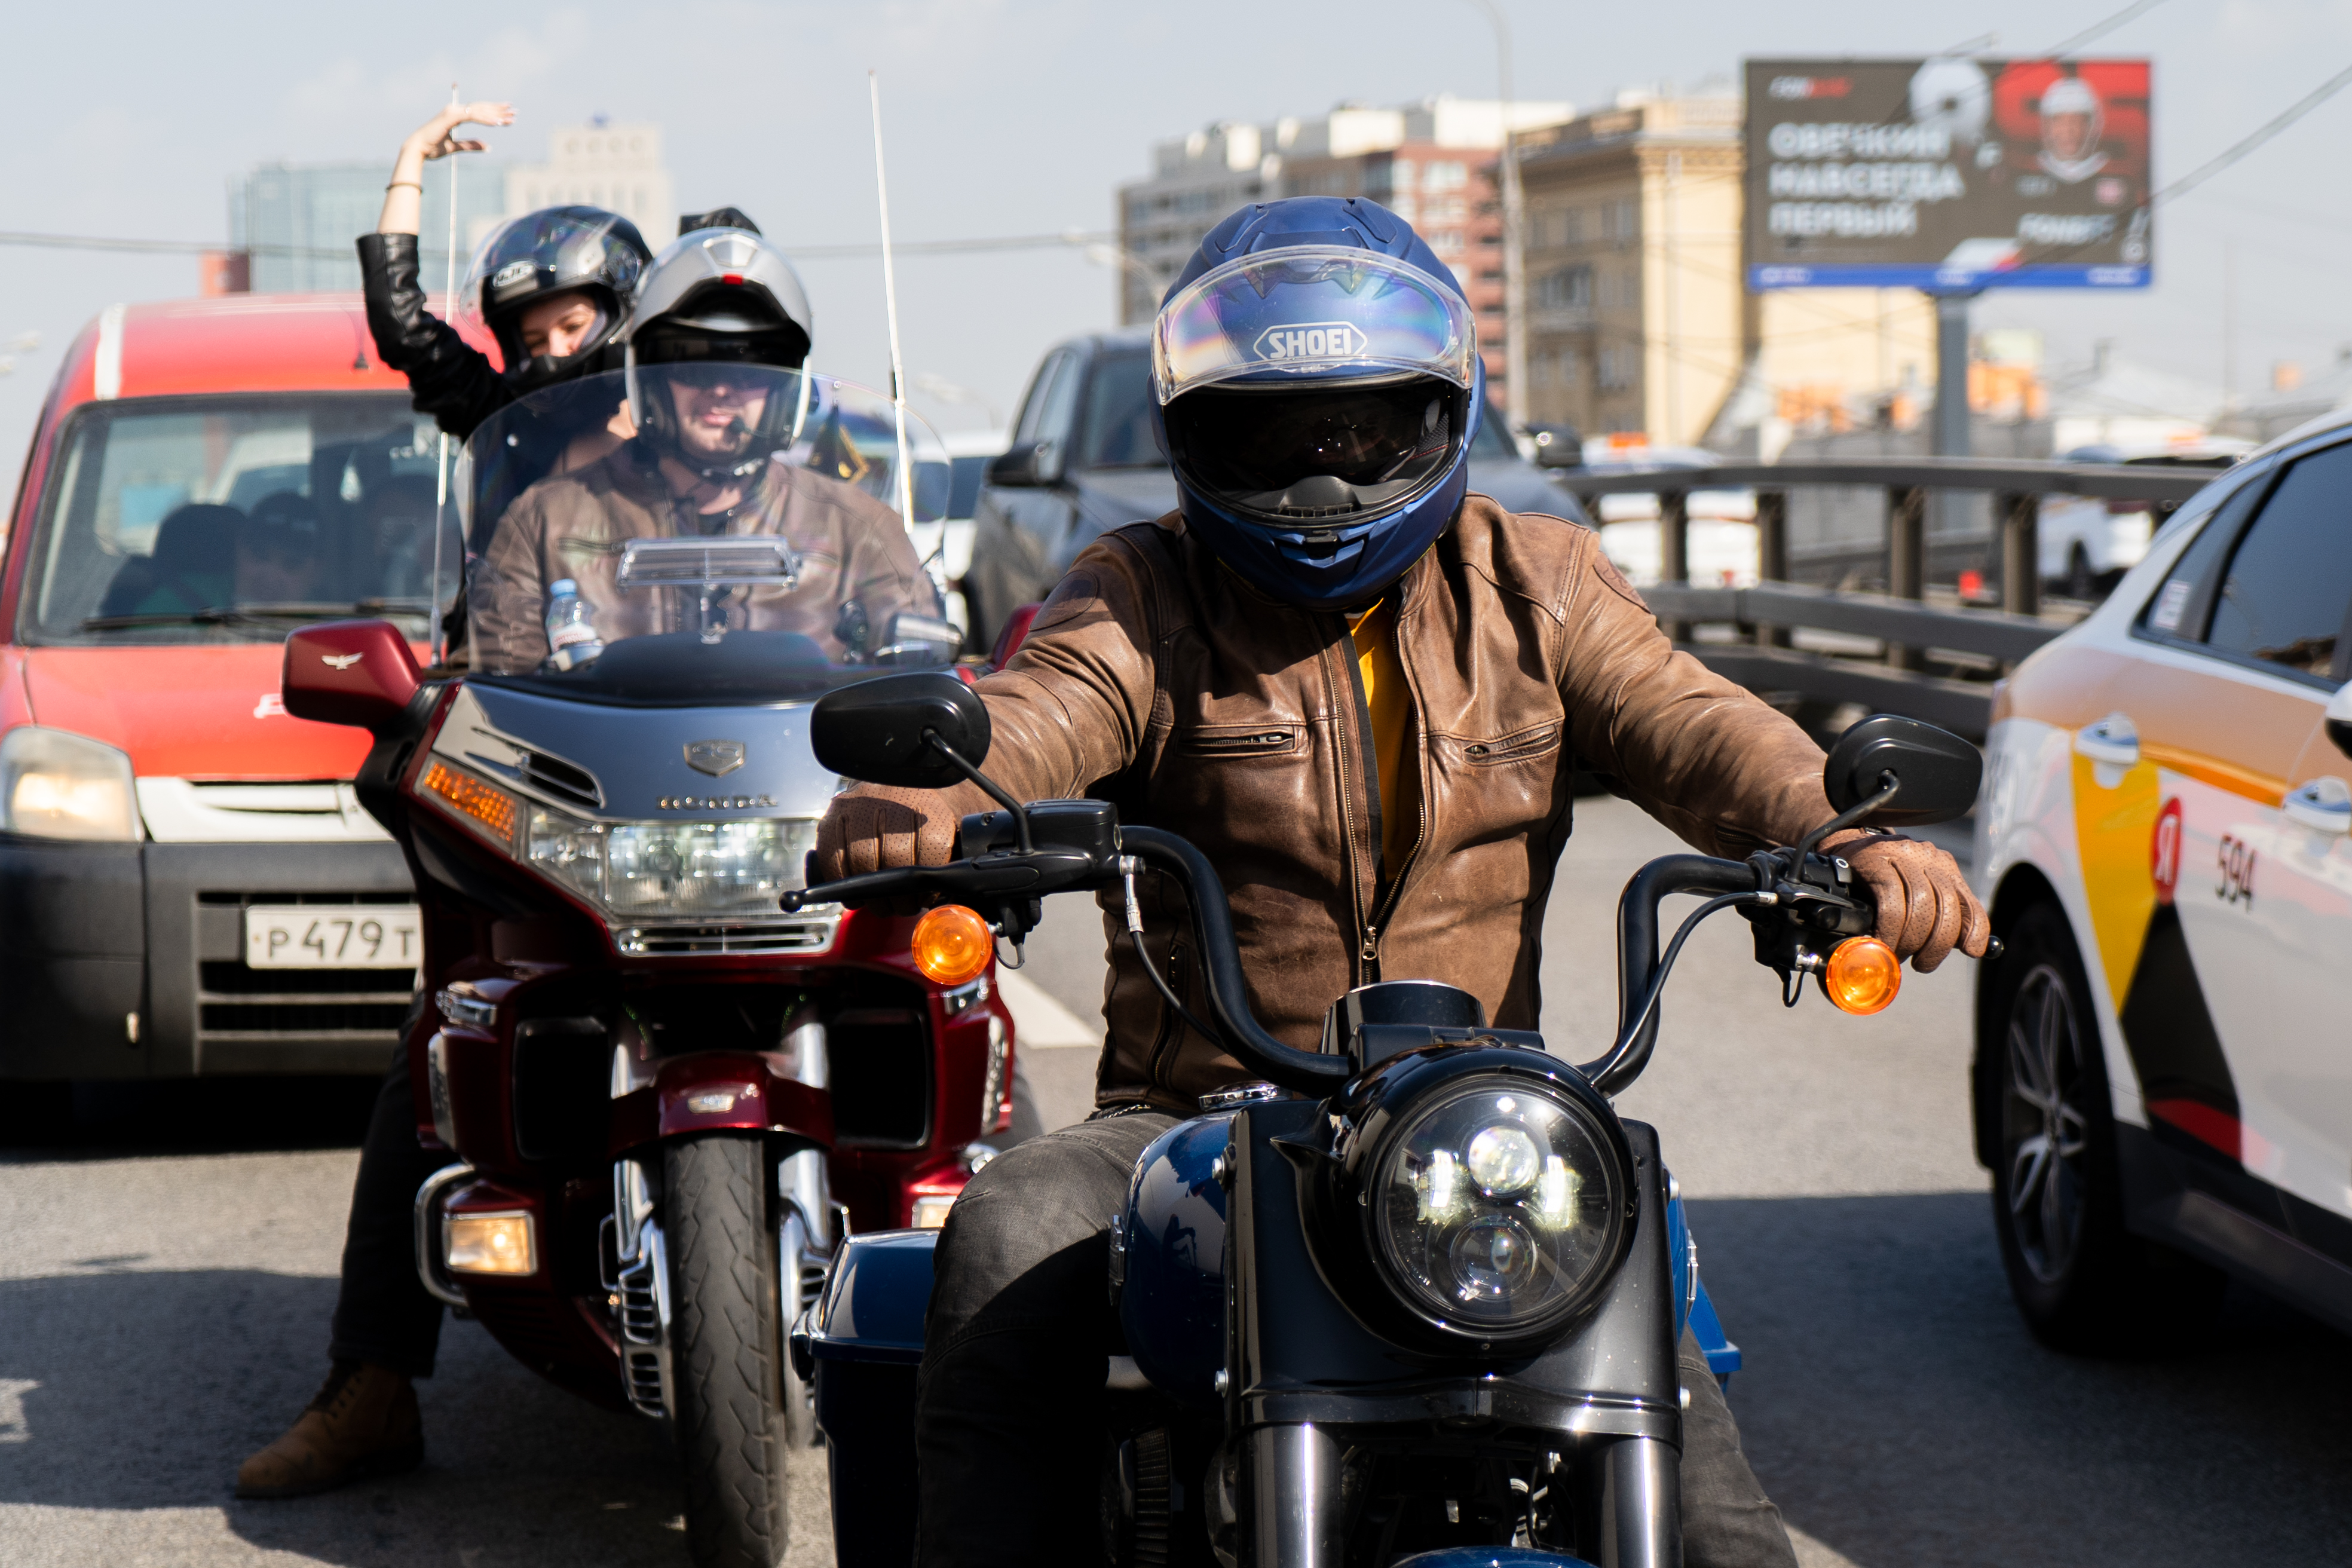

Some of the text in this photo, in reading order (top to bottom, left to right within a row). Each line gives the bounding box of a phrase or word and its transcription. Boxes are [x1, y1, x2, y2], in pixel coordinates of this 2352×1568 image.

[1769, 122, 1951, 160] ОВЕЧКИН
[1769, 162, 1965, 201] НАВСЕГДА
[1769, 202, 1916, 237] ПЕРВЫЙ
[1268, 328, 1352, 359] SHOEI
[656, 794, 779, 810] HONDA
[2215, 833, 2256, 913] 594
